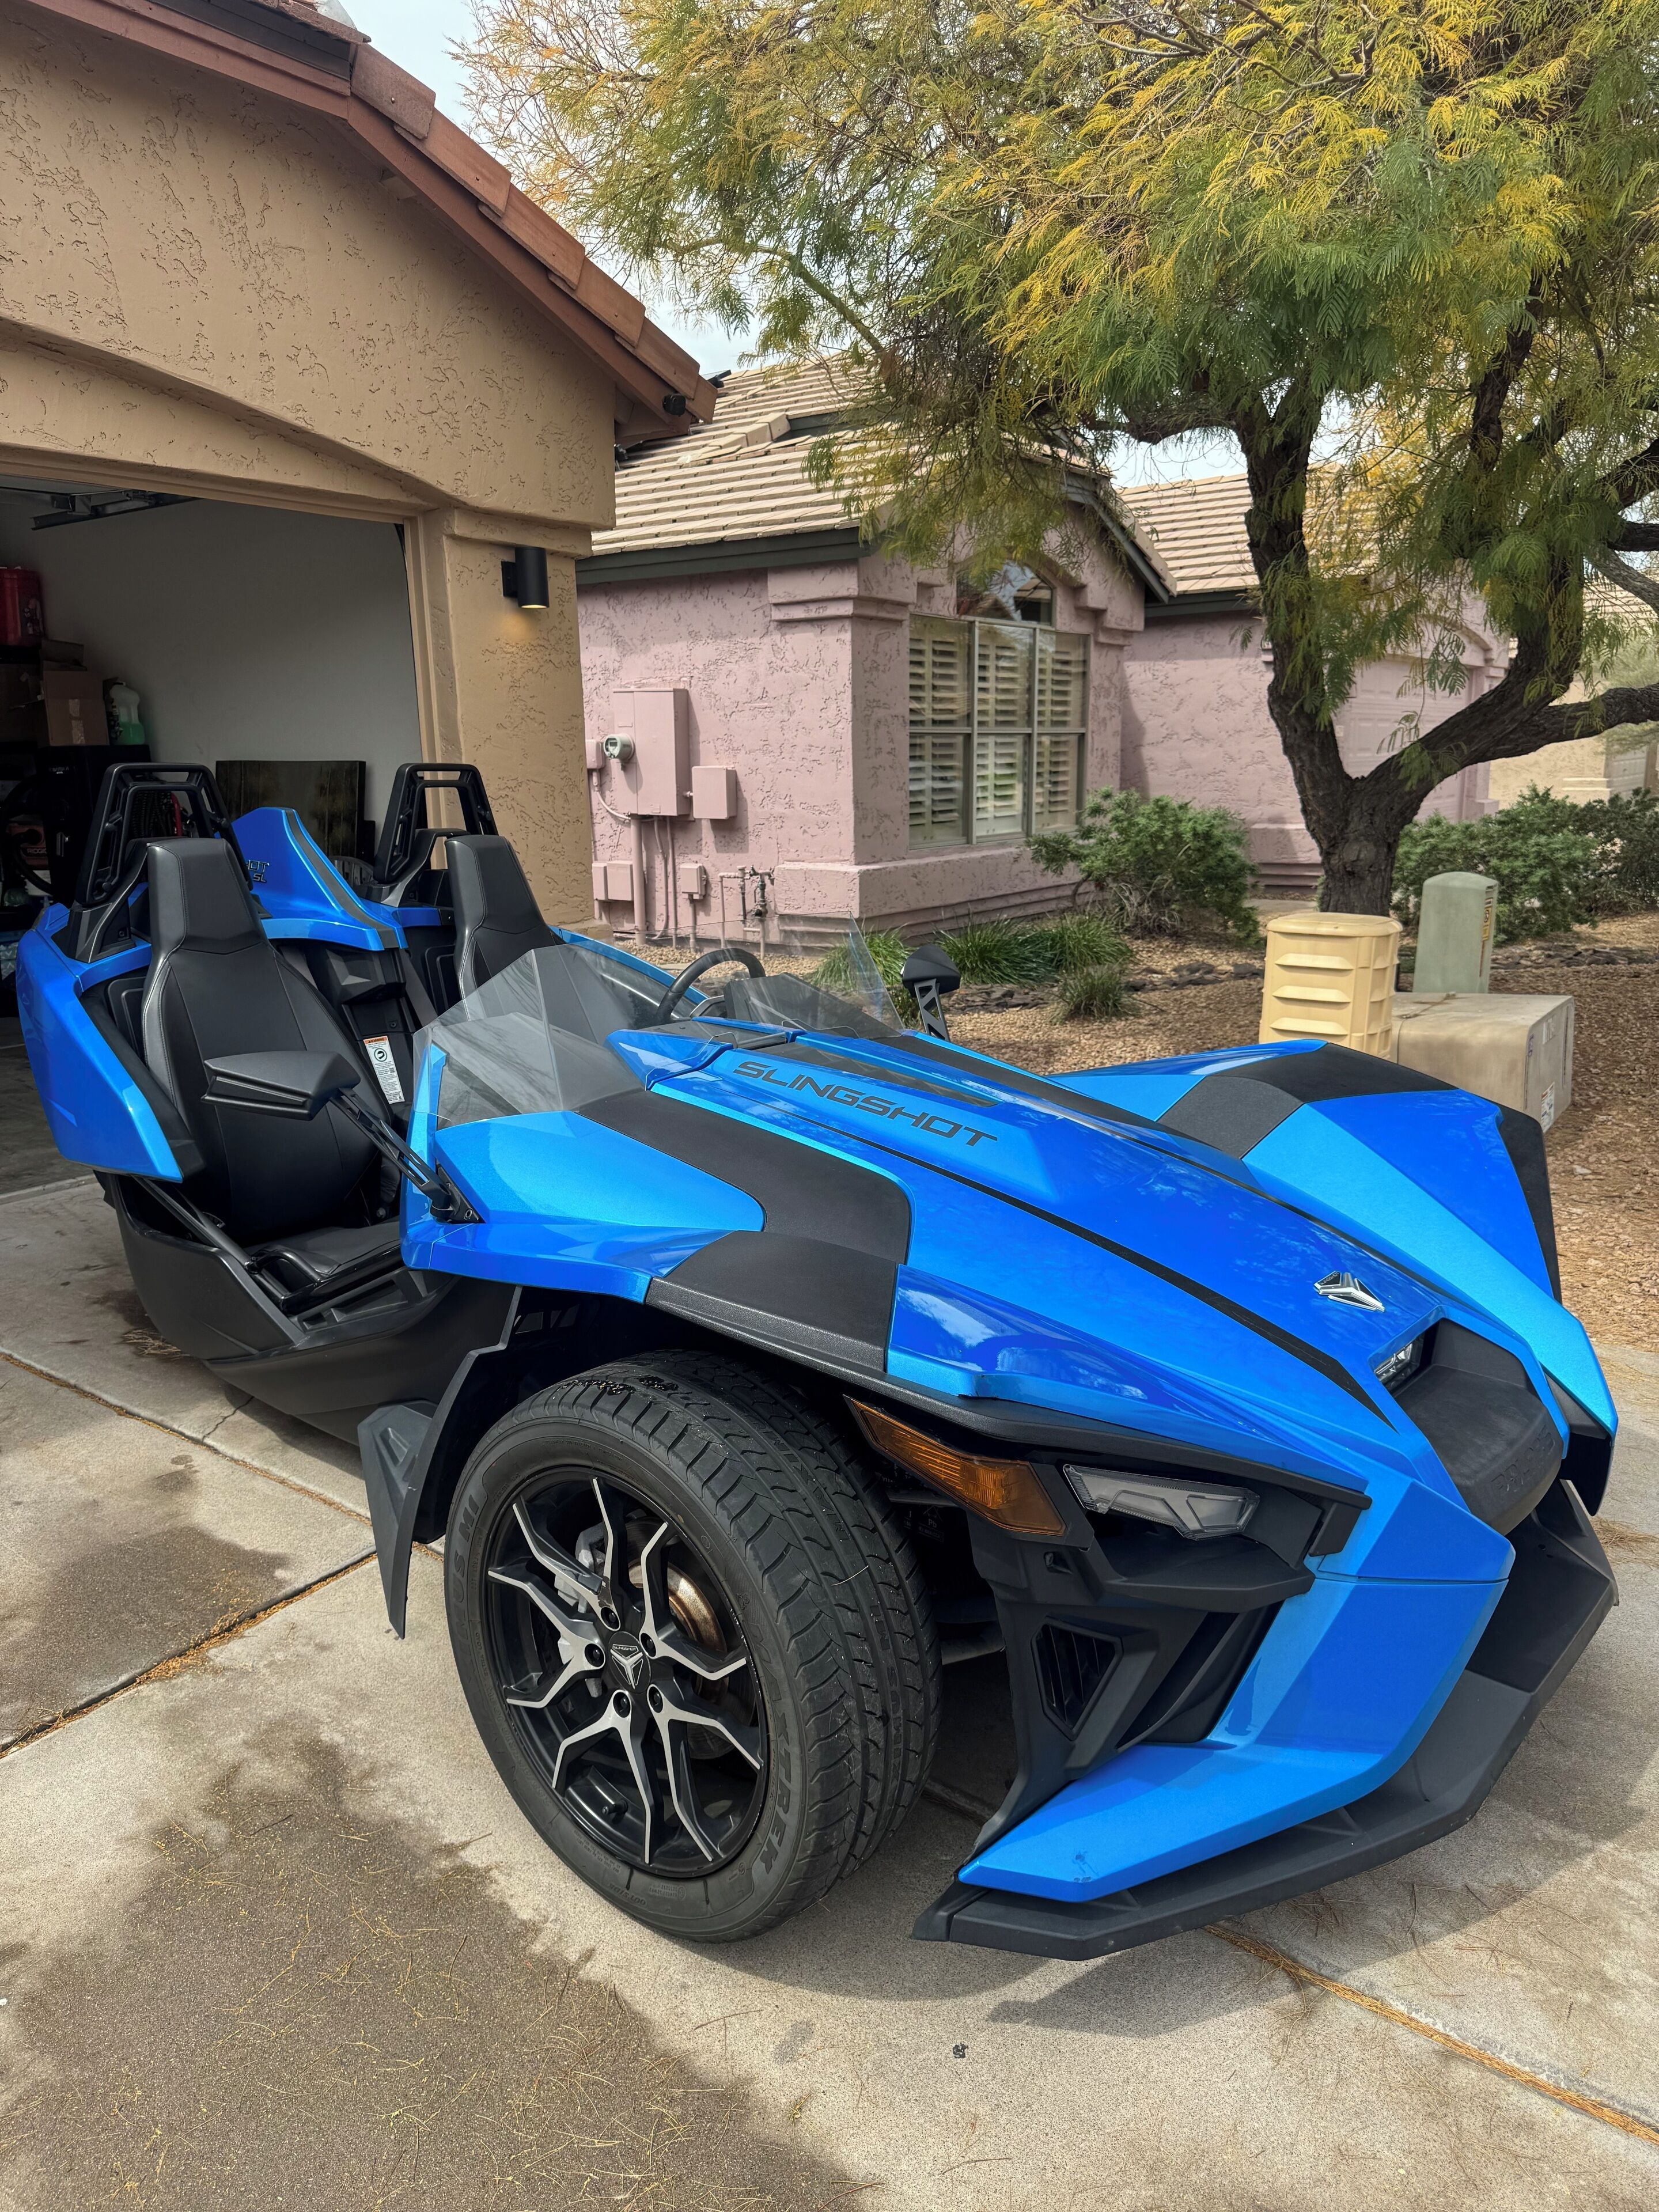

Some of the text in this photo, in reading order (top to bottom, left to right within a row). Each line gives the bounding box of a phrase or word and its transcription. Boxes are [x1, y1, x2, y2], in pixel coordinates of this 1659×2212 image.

[245, 859, 270, 872] OT
[253, 873, 266, 882] SL
[733, 1061, 998, 1146] SLINGSHOT
[750, 1623, 791, 1874] MAXTREK
